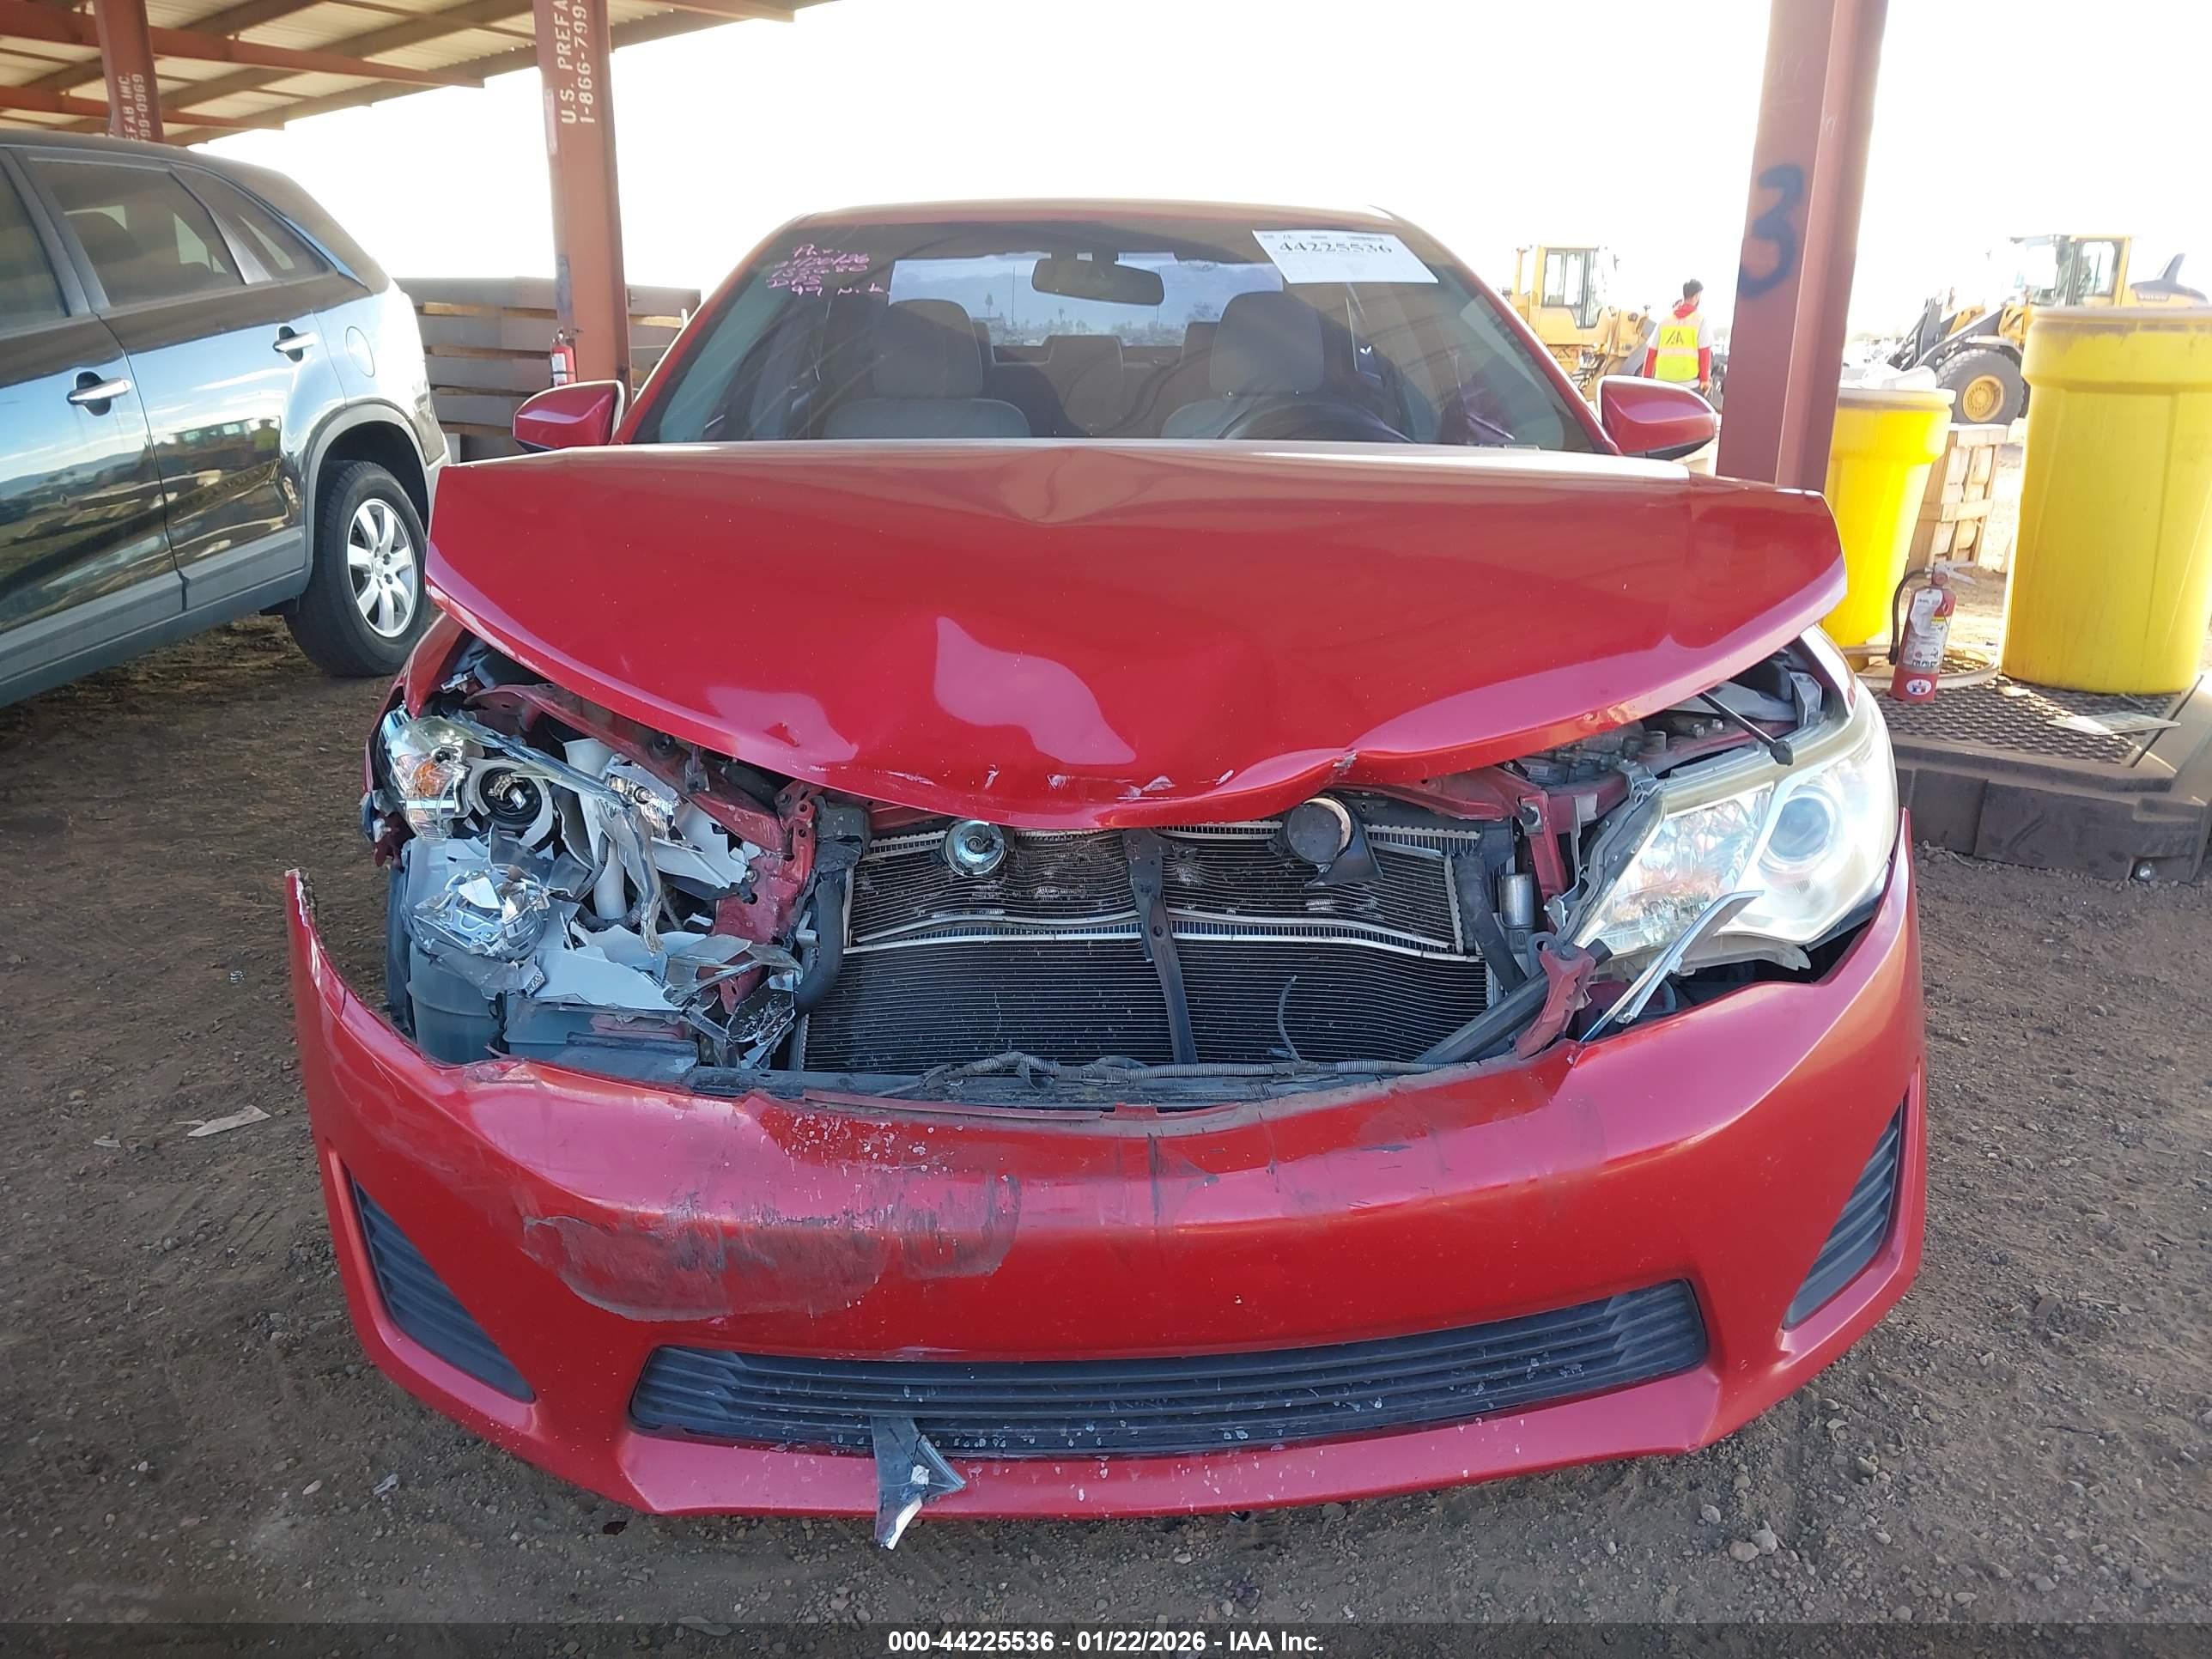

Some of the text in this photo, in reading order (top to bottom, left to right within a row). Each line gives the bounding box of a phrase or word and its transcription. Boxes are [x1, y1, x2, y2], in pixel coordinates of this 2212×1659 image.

[560, 83, 576, 124] U.S.
[1279, 240, 1394, 254] 44225536
[1737, 161, 1806, 298] 3
